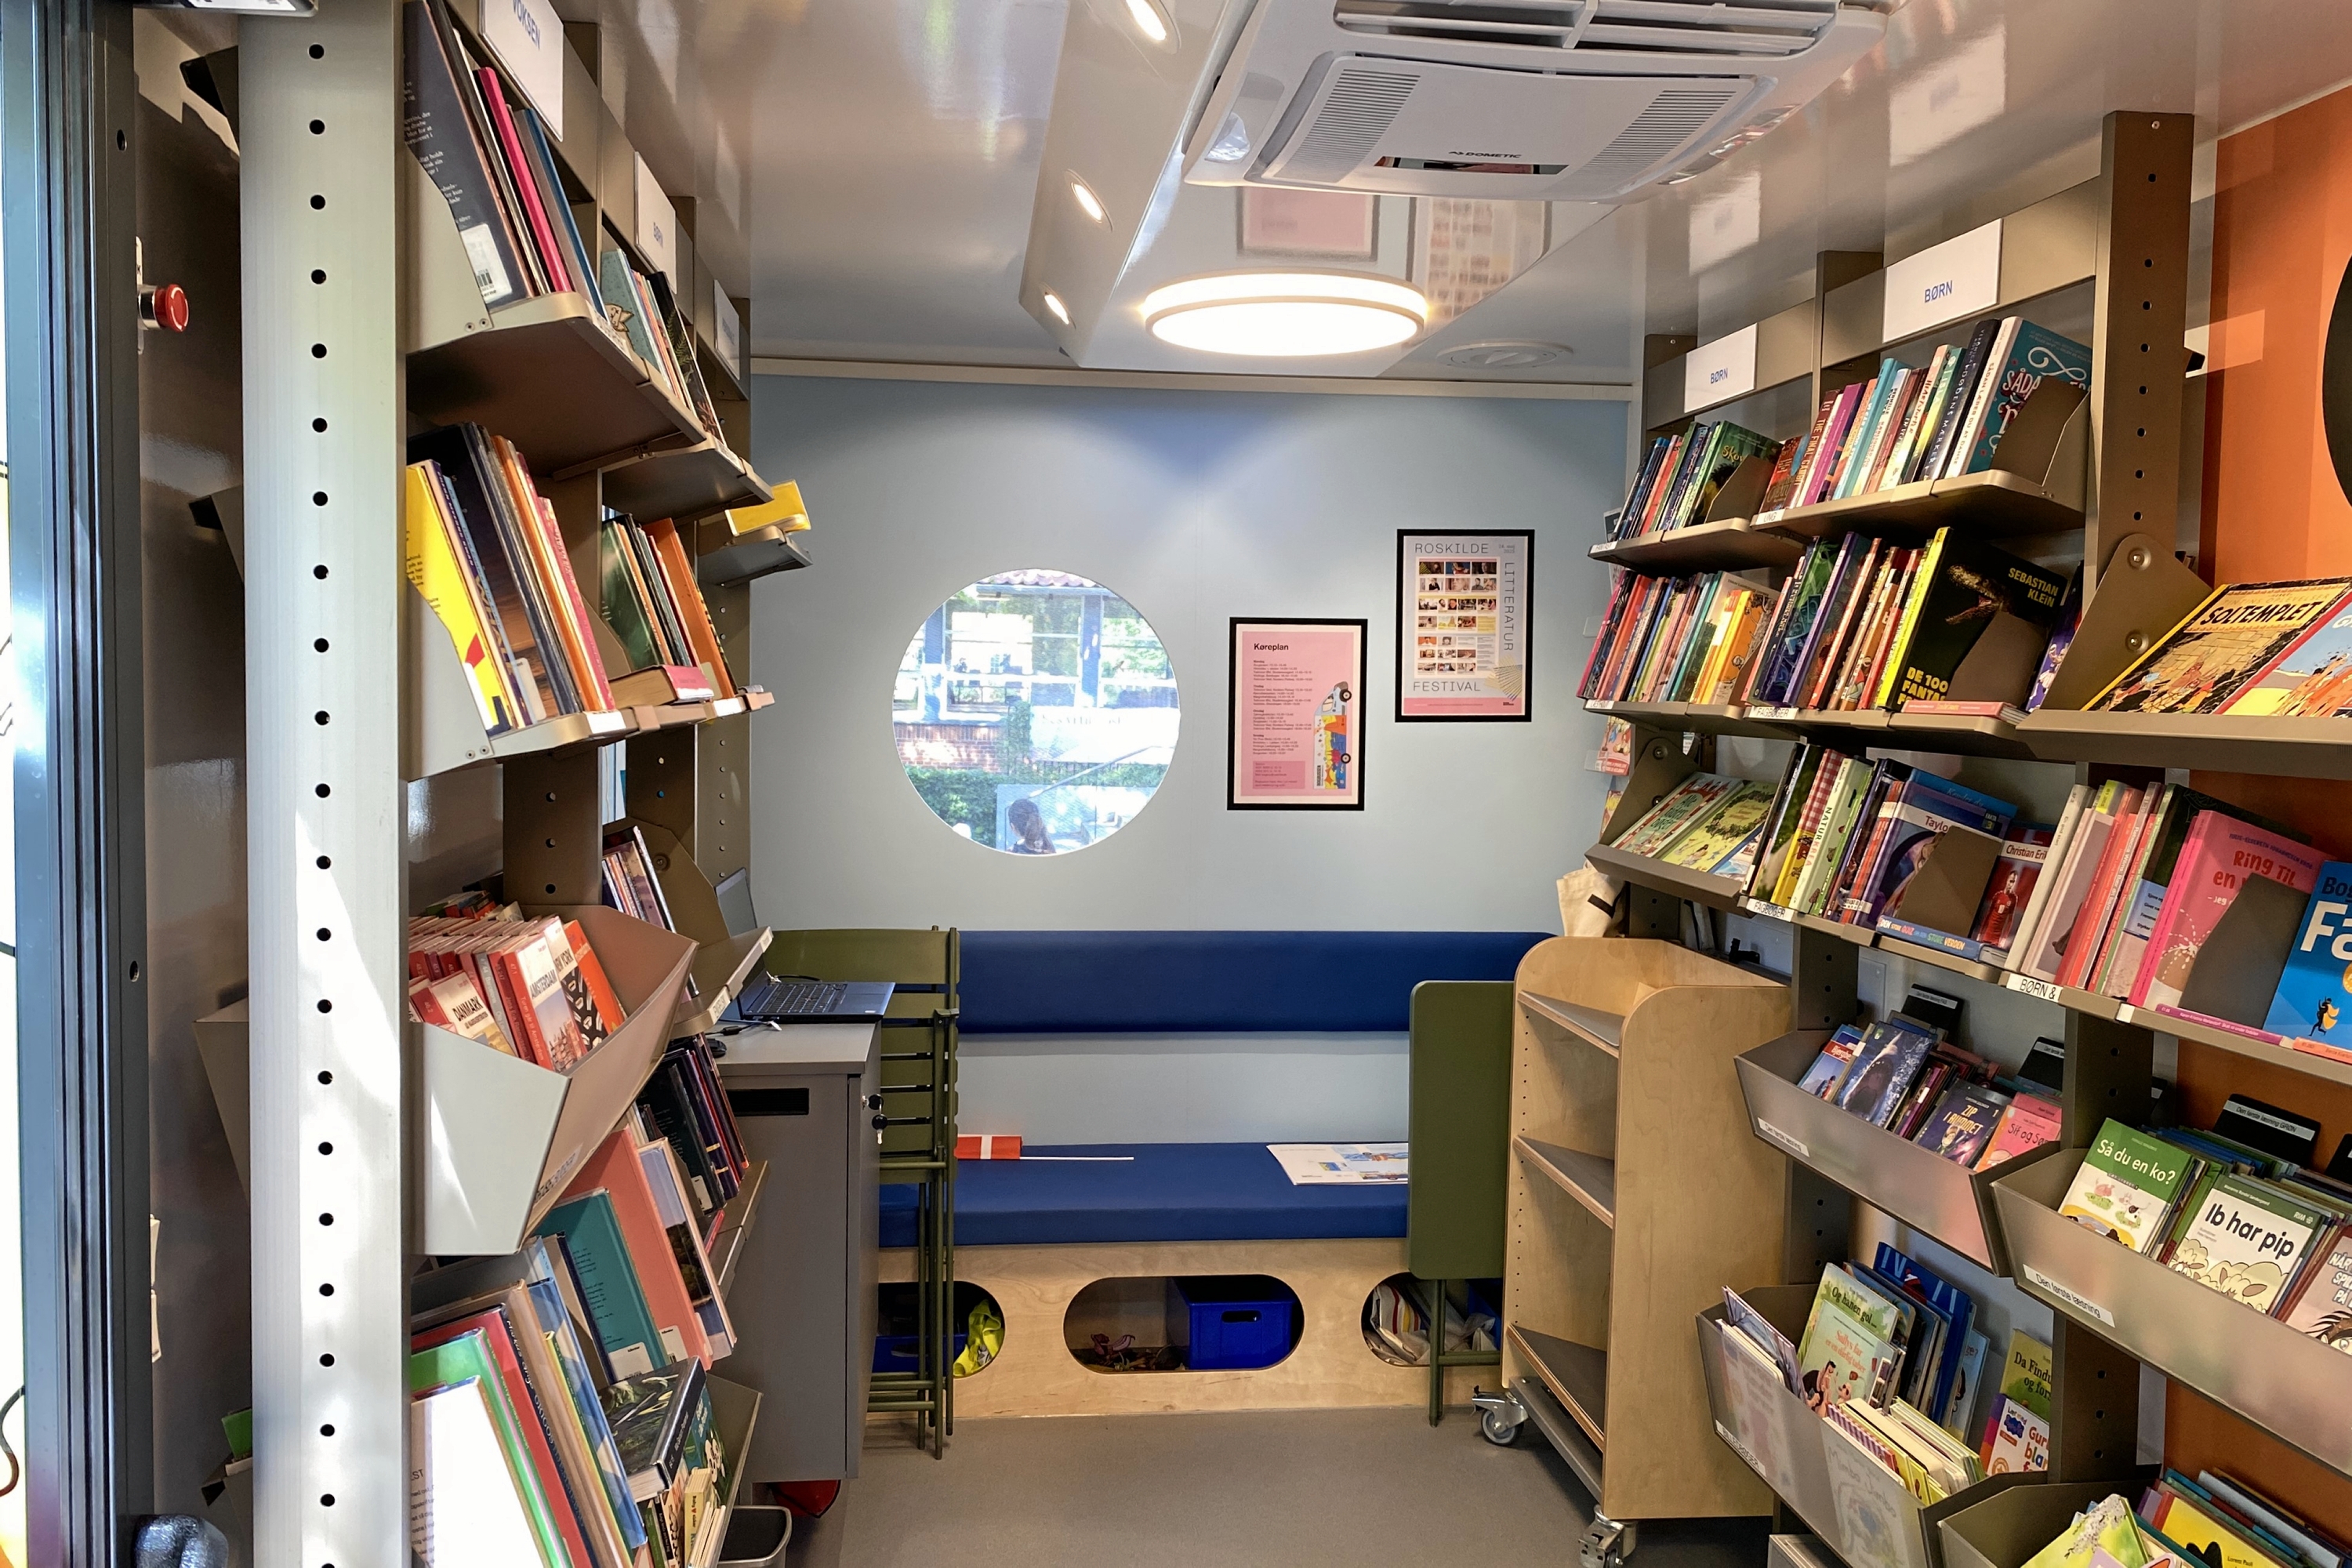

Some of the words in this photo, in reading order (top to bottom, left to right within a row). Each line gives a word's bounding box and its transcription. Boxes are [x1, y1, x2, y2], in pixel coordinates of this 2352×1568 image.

[513, 0, 541, 50] VOKSEN
[1925, 281, 1953, 303] BØRN
[1710, 367, 1729, 385] BØRN
[1812, 416, 1826, 435] THE
[1803, 433, 1819, 459] FINAL
[1792, 457, 1810, 487] GAMBIT
[1763, 514, 1777, 522] UNG
[1414, 543, 1489, 554] ROSKILDE
[2008, 568, 2059, 597] SEBASTIAN
[1504, 562, 1515, 651] LITTERATUR
[2200, 601, 2325, 625] SOLTEMPLET
[1413, 681, 1480, 691] FESTIVAL
[1906, 666, 1923, 681] DE
[1925, 674, 1948, 693] 100
[1757, 707, 1789, 718] FAGBØGER
[1925, 815, 1948, 832] Taylo
[2006, 844, 2034, 858] Christian
[2233, 850, 2274, 875] Ring
[2276, 865, 2296, 886] Til
[2212, 870, 2235, 889] en
[2321, 877, 2352, 902] Bo
[1754, 902, 1785, 917] FAGBØGER
[1879, 918, 1892, 929] DEN
[1943, 936, 1965, 950] VERDEN
[529, 969, 557, 999] AMSTERDAM
[2019, 978, 2047, 996] BØRN
[2048, 987, 2056, 999] &
[452, 996, 484, 1022] DANMARK
[520, 996, 529, 1013] Turen
[524, 1012, 533, 1023] går
[530, 1029, 545, 1061] Amsterdam
[1961, 1105, 1978, 1117] ZIP
[2008, 1123, 2020, 1136] Sif
[2020, 1131, 2033, 1144] og
[2097, 1139, 2114, 1157] Så
[2114, 1146, 2129, 1164] du
[2132, 1159, 2149, 1174] en
[2151, 1162, 2176, 1185] ko?
[2205, 1203, 2226, 1226] Ib
[2226, 1210, 2263, 1240] har
[2257, 1231, 2294, 1260] pip
[2328, 1251, 2350, 1270] NÅR
[1831, 1287, 1842, 1302] Og
[1842, 1293, 1860, 1316] hanen
[2036, 1273, 2050, 1288] Den
[2071, 1294, 2100, 1318] læsning
[2332, 1288, 2349, 1305] PÅ
[2014, 1352, 2027, 1368] Da
[2024, 1377, 2034, 1393] og
[2029, 1426, 2049, 1450] Gur
